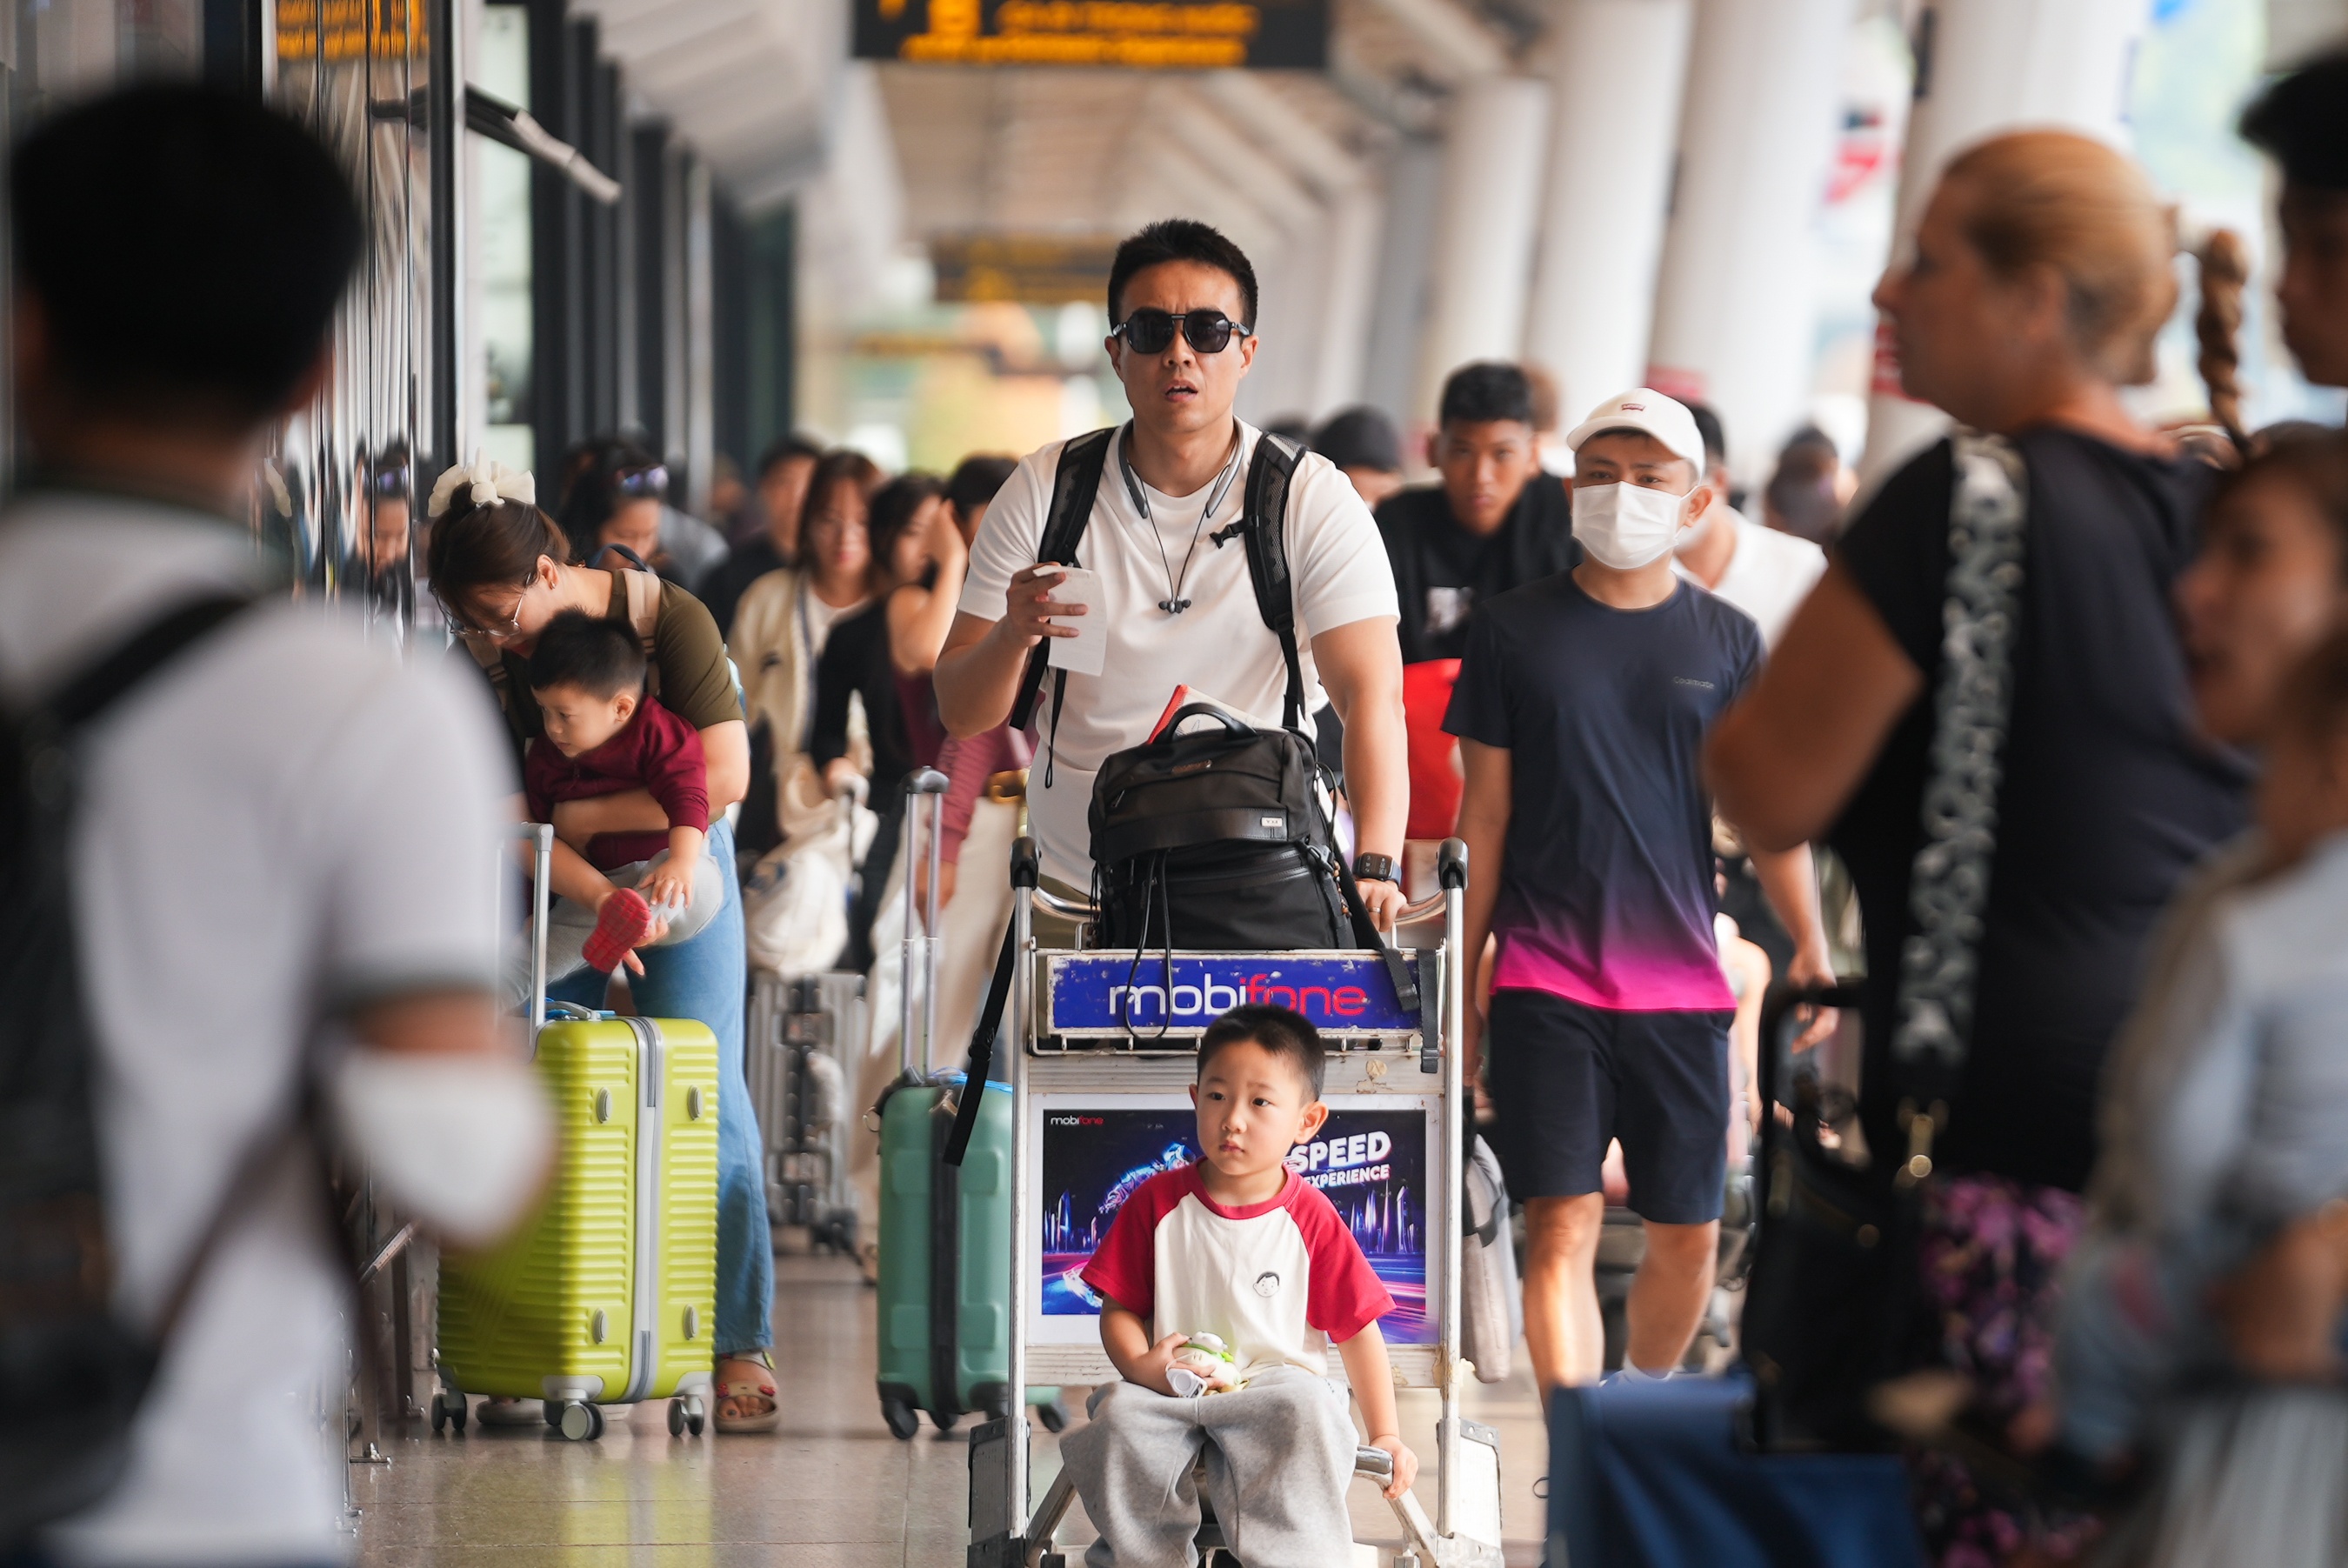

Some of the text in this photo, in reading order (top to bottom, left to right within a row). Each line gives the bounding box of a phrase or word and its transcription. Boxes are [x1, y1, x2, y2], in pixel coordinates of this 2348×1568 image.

[1109, 973, 1367, 1015] mobifone
[1051, 1115, 1104, 1125] mobifone
[1288, 1131, 1391, 1172] SPEED
